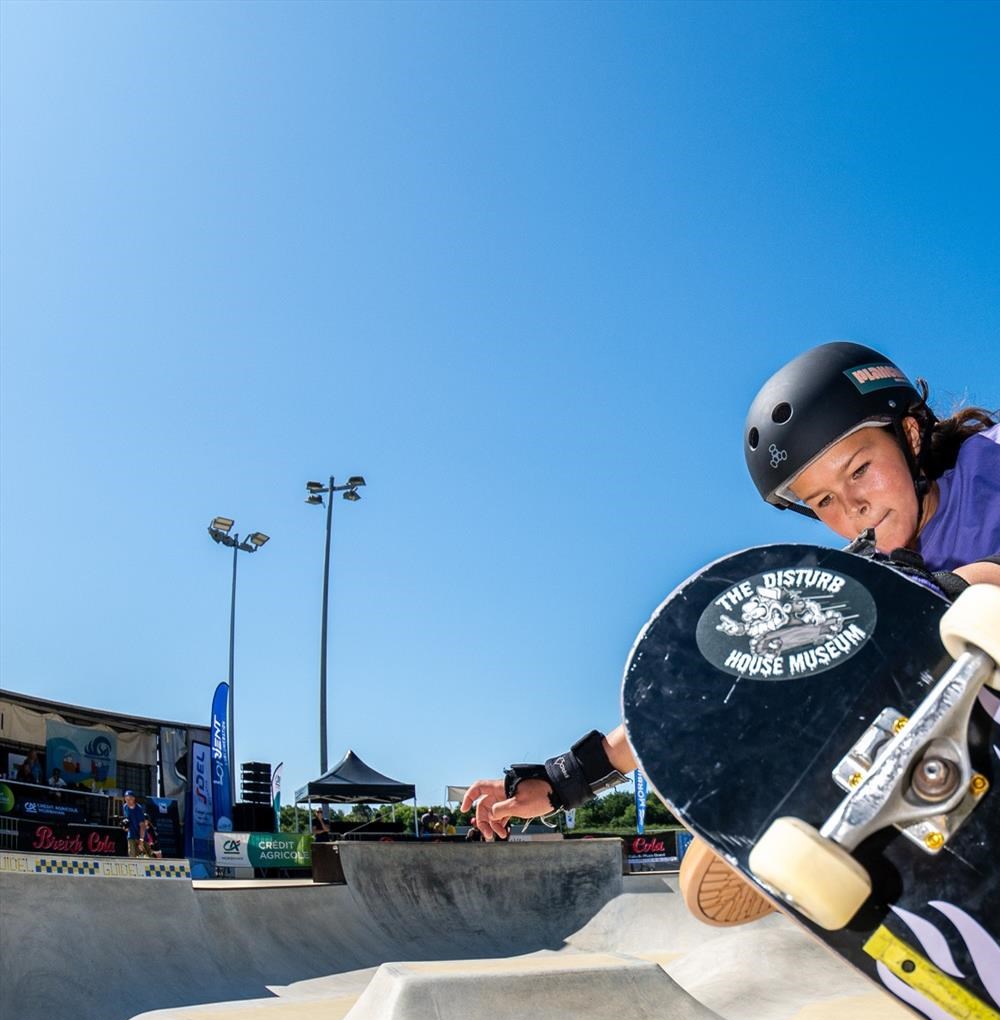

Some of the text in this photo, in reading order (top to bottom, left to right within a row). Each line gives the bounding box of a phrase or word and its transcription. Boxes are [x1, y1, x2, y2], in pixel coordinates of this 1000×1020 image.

[715, 569, 846, 611] THE DISTURB
[724, 623, 867, 678] HOUSE MUSEUM
[32, 825, 116, 854] Breizh Cola
[258, 839, 294, 850] CRÉDIT
[632, 836, 666, 853] Cola
[260, 850, 310, 860] AGRICOLE
